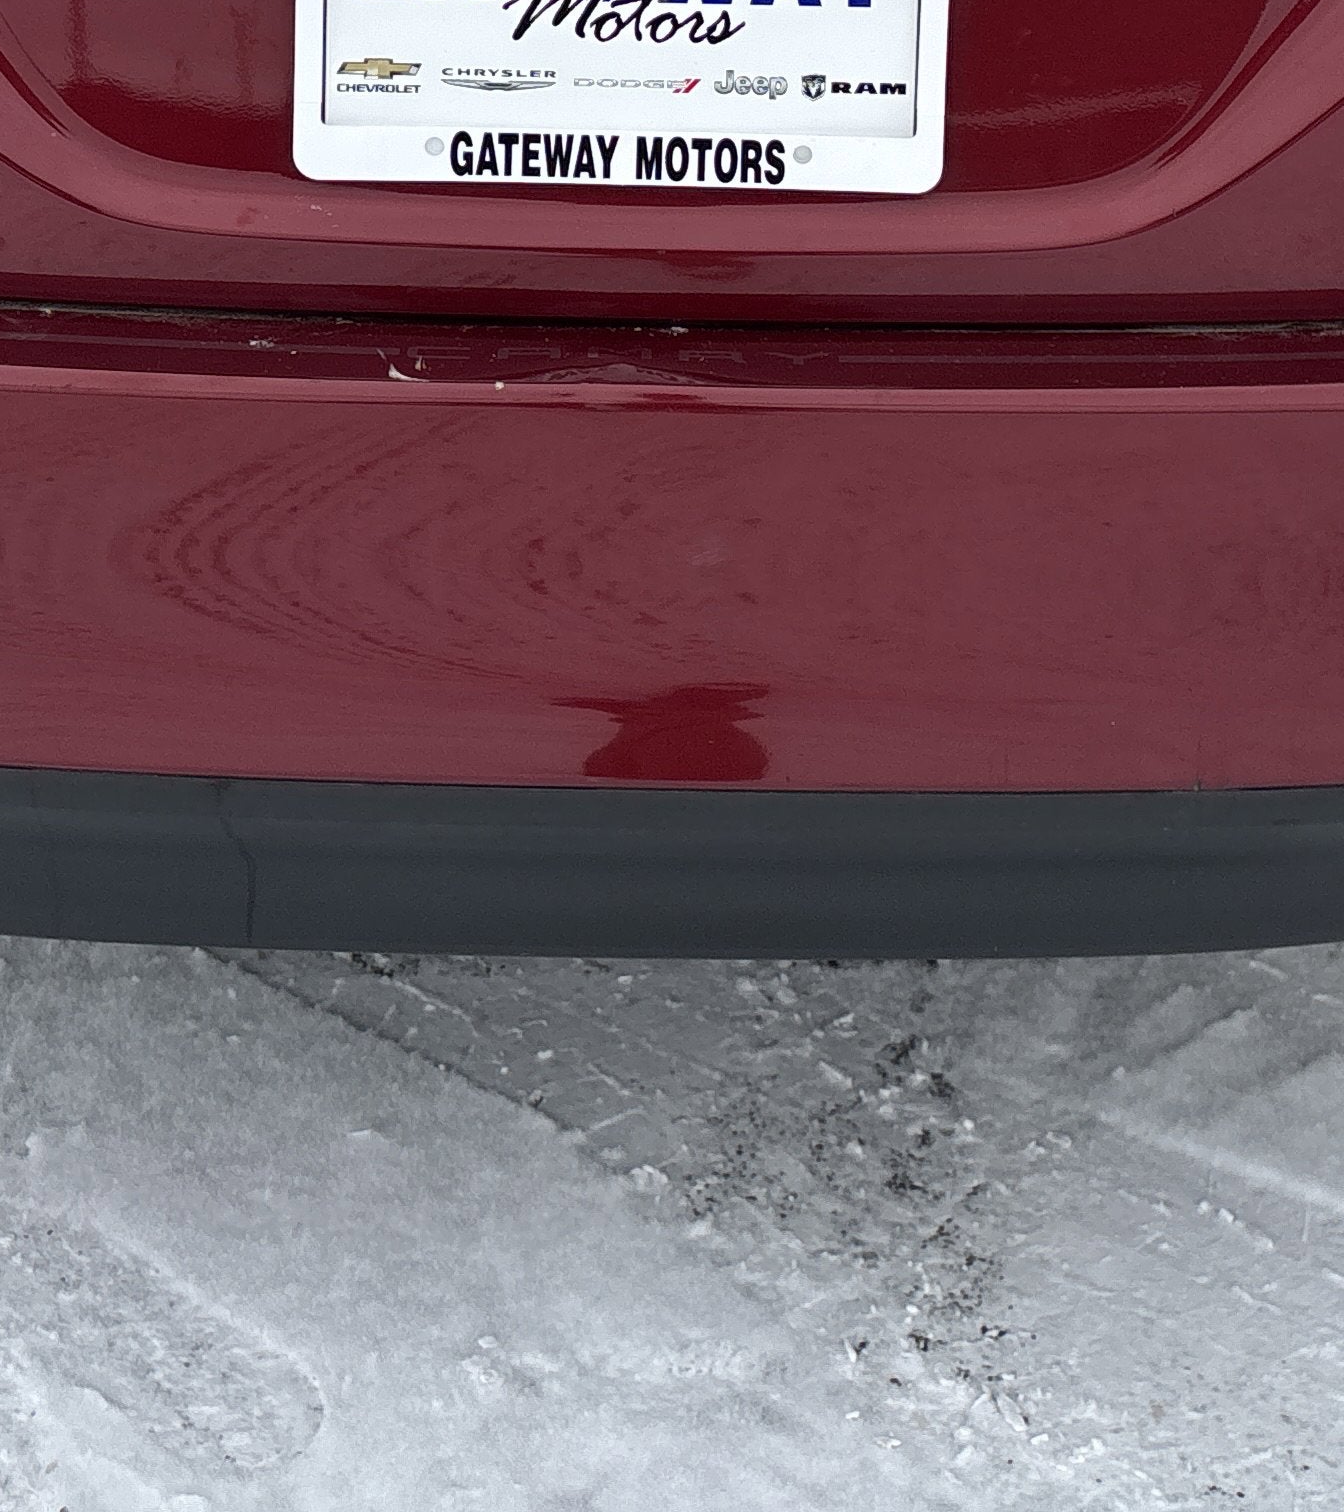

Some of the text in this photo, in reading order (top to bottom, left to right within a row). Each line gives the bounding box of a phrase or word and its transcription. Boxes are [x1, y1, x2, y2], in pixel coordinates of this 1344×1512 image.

[336, 67, 907, 100] CHEVROLET CHRYSLER DODGE Jeep RAM
[449, 130, 786, 186] GATEWAY MOTORS
